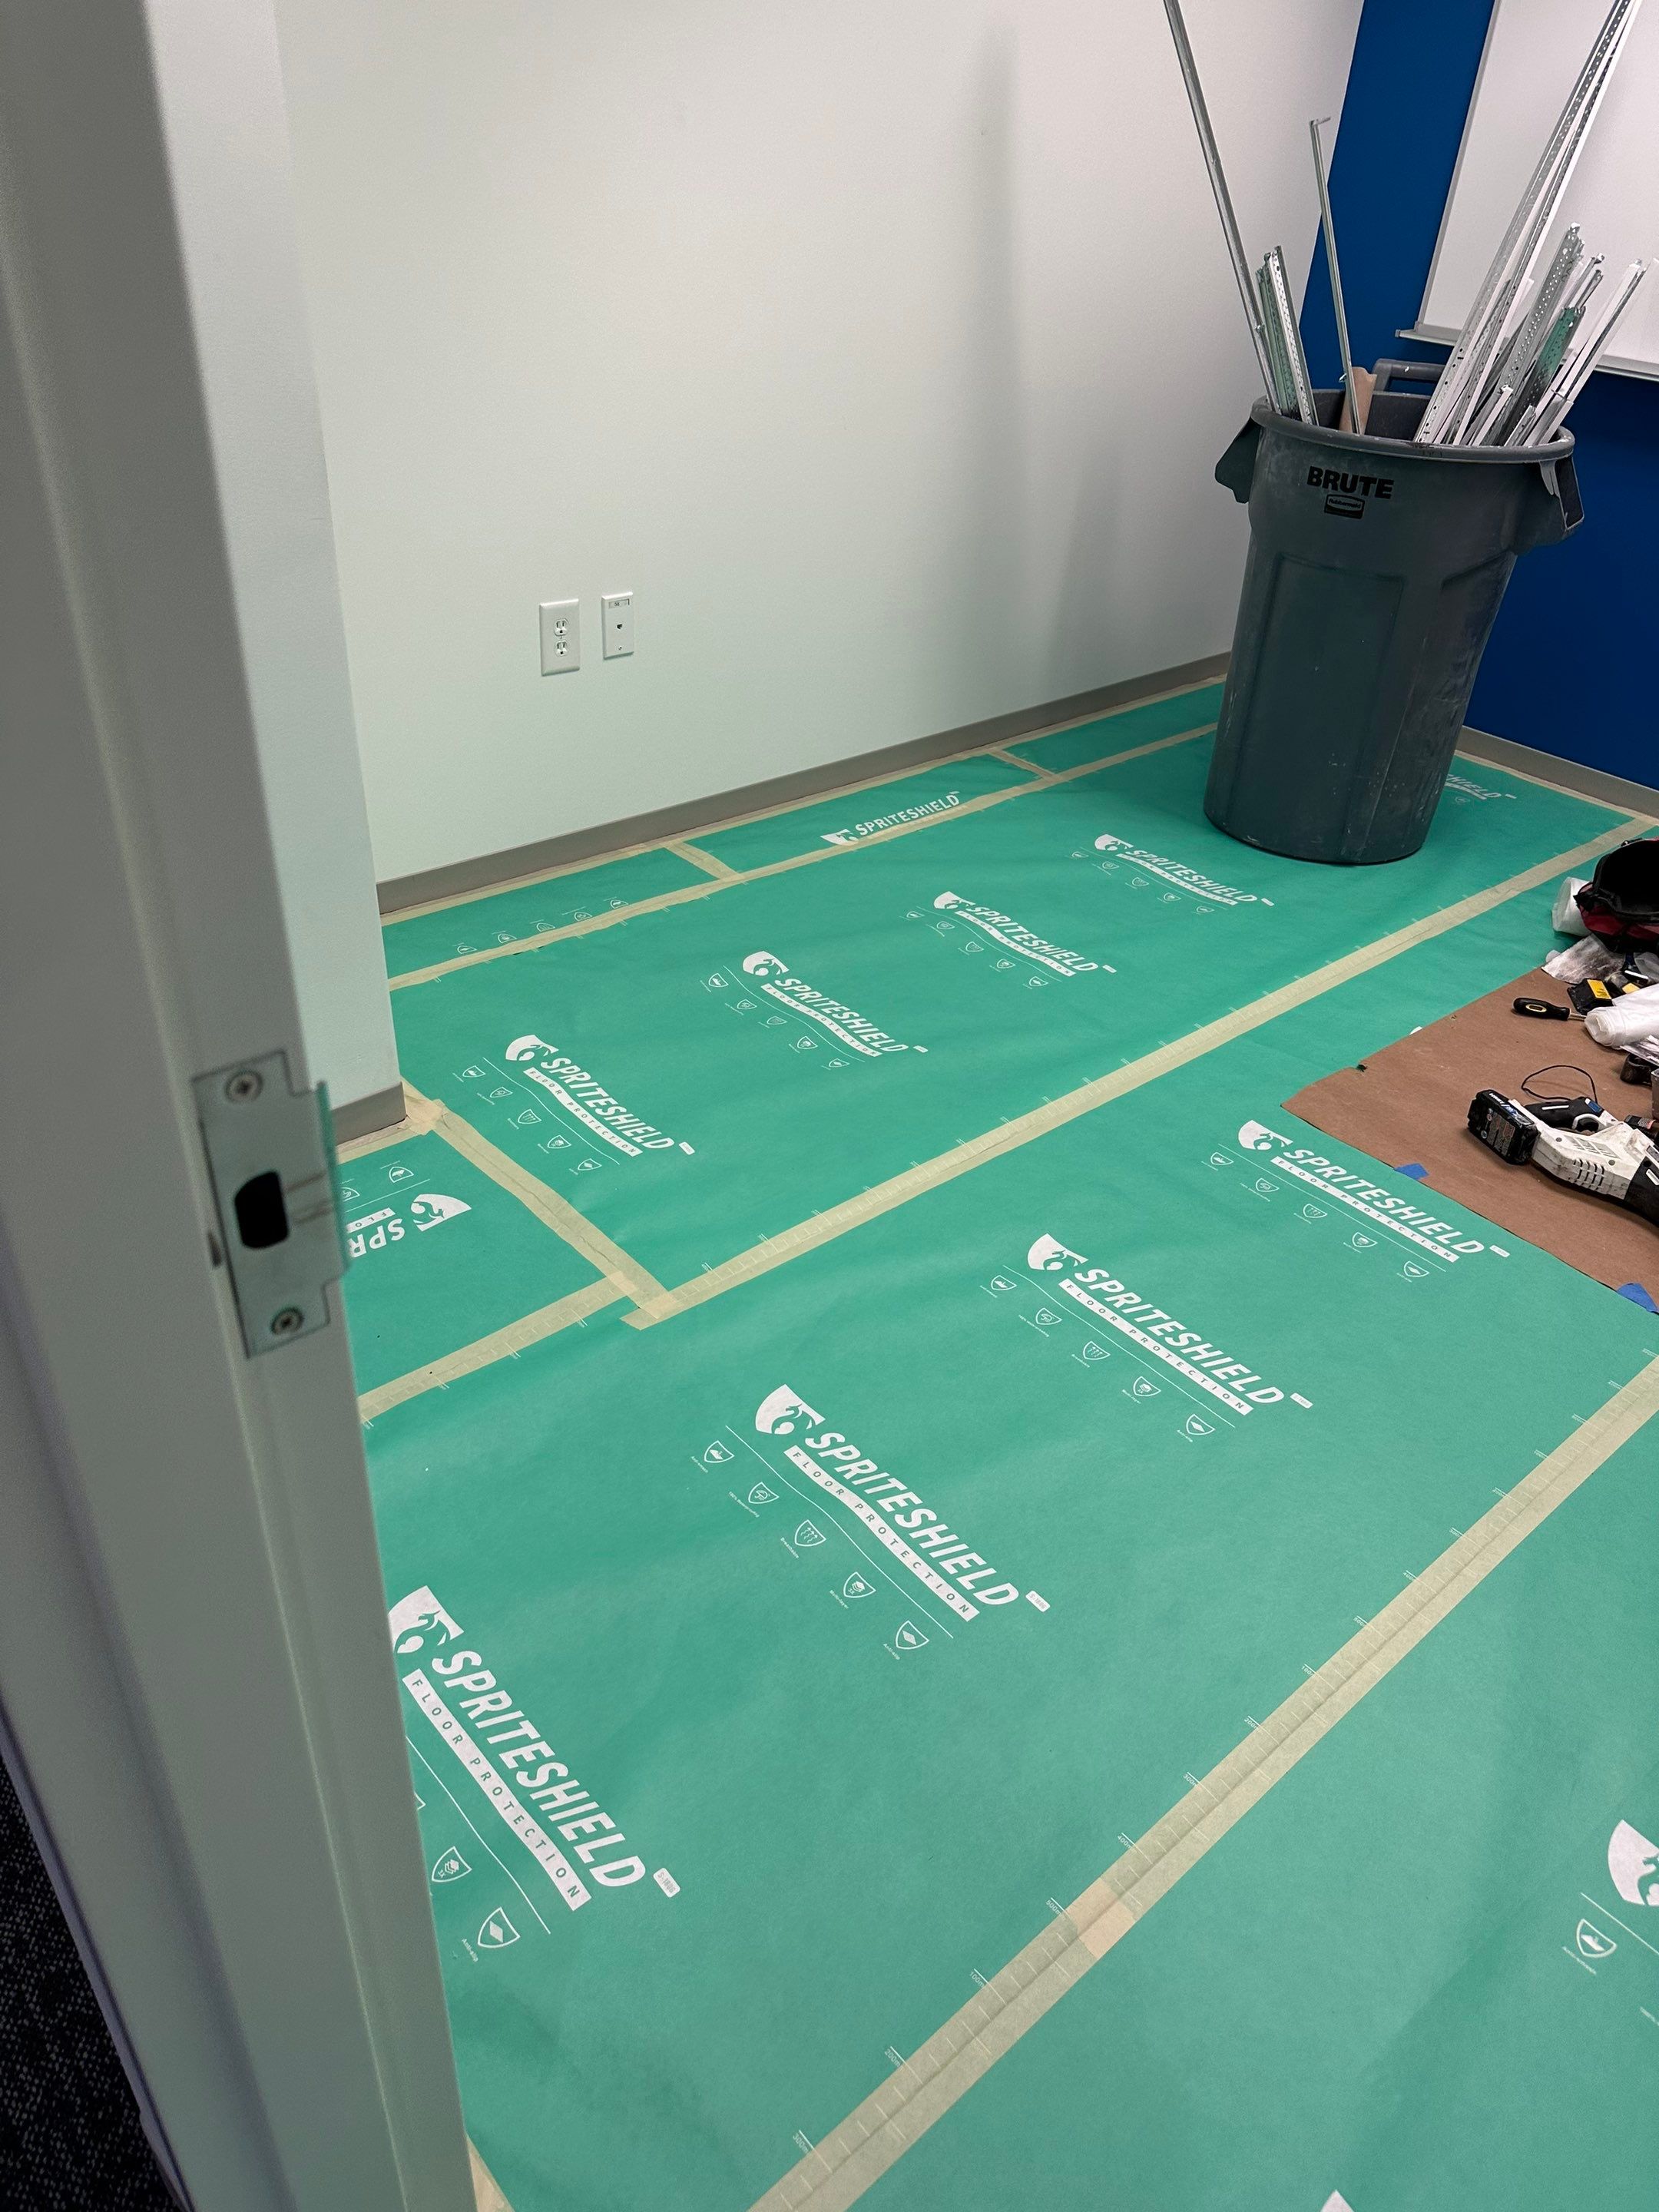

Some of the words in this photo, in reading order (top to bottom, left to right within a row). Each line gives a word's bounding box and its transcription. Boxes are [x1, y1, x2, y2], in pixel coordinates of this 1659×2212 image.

[1306, 465, 1395, 499] BRUTE
[855, 793, 960, 836] SPRITESHIELD
[1125, 849, 1258, 902] SPRITESHIELD
[967, 906, 1099, 972] SPRITESHIELD
[774, 978, 909, 1053] SPRITESHIELD
[529, 1071, 563, 1095] FLOOR
[567, 1101, 636, 1154] PROTECTION
[540, 1058, 675, 1149] SPRITESHIELD
[356, 1211, 387, 1228] FLO
[1278, 1160, 1329, 1189] FLOOR
[1340, 1194, 1452, 1258] PROTECTION
[1283, 1149, 1485, 1253] SPRITESHIELD
[1066, 1284, 1118, 1322] FLOOR
[1129, 1329, 1245, 1409] PROTECTION
[1075, 1269, 1285, 1404] SPRITESHIELD
[793, 1451, 845, 1498] FLOOR
[855, 1503, 970, 1613] PROTECTION
[804, 1432, 1020, 1605] SPRITESHIELD
[412, 1679, 463, 1745] FLOOR
[470, 1757, 580, 1898] PROTECTION
[431, 1651, 646, 1887] SPRITESHIELD
